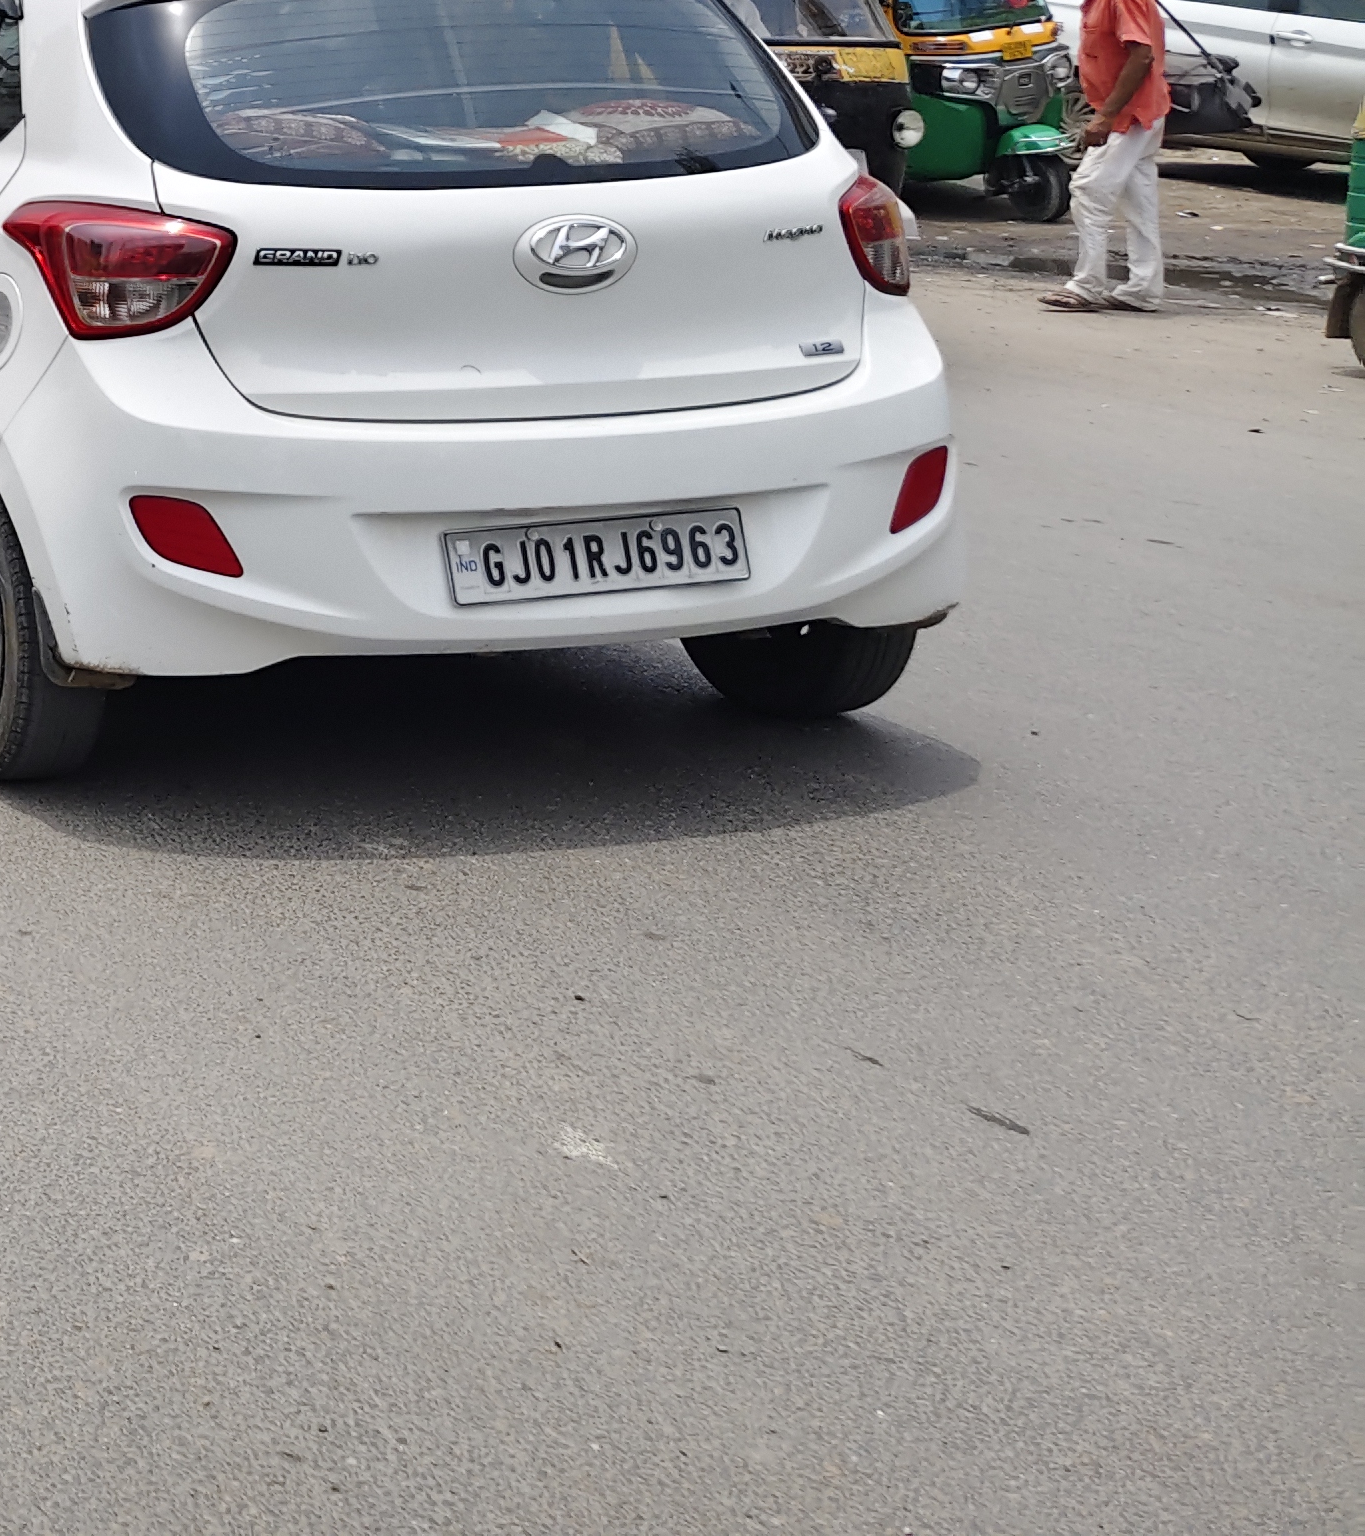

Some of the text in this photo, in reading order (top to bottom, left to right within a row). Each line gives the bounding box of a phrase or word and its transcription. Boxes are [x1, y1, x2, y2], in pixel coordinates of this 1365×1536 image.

[258, 250, 338, 263] GRAND
[455, 522, 739, 588] IND GJ01RJ6963
